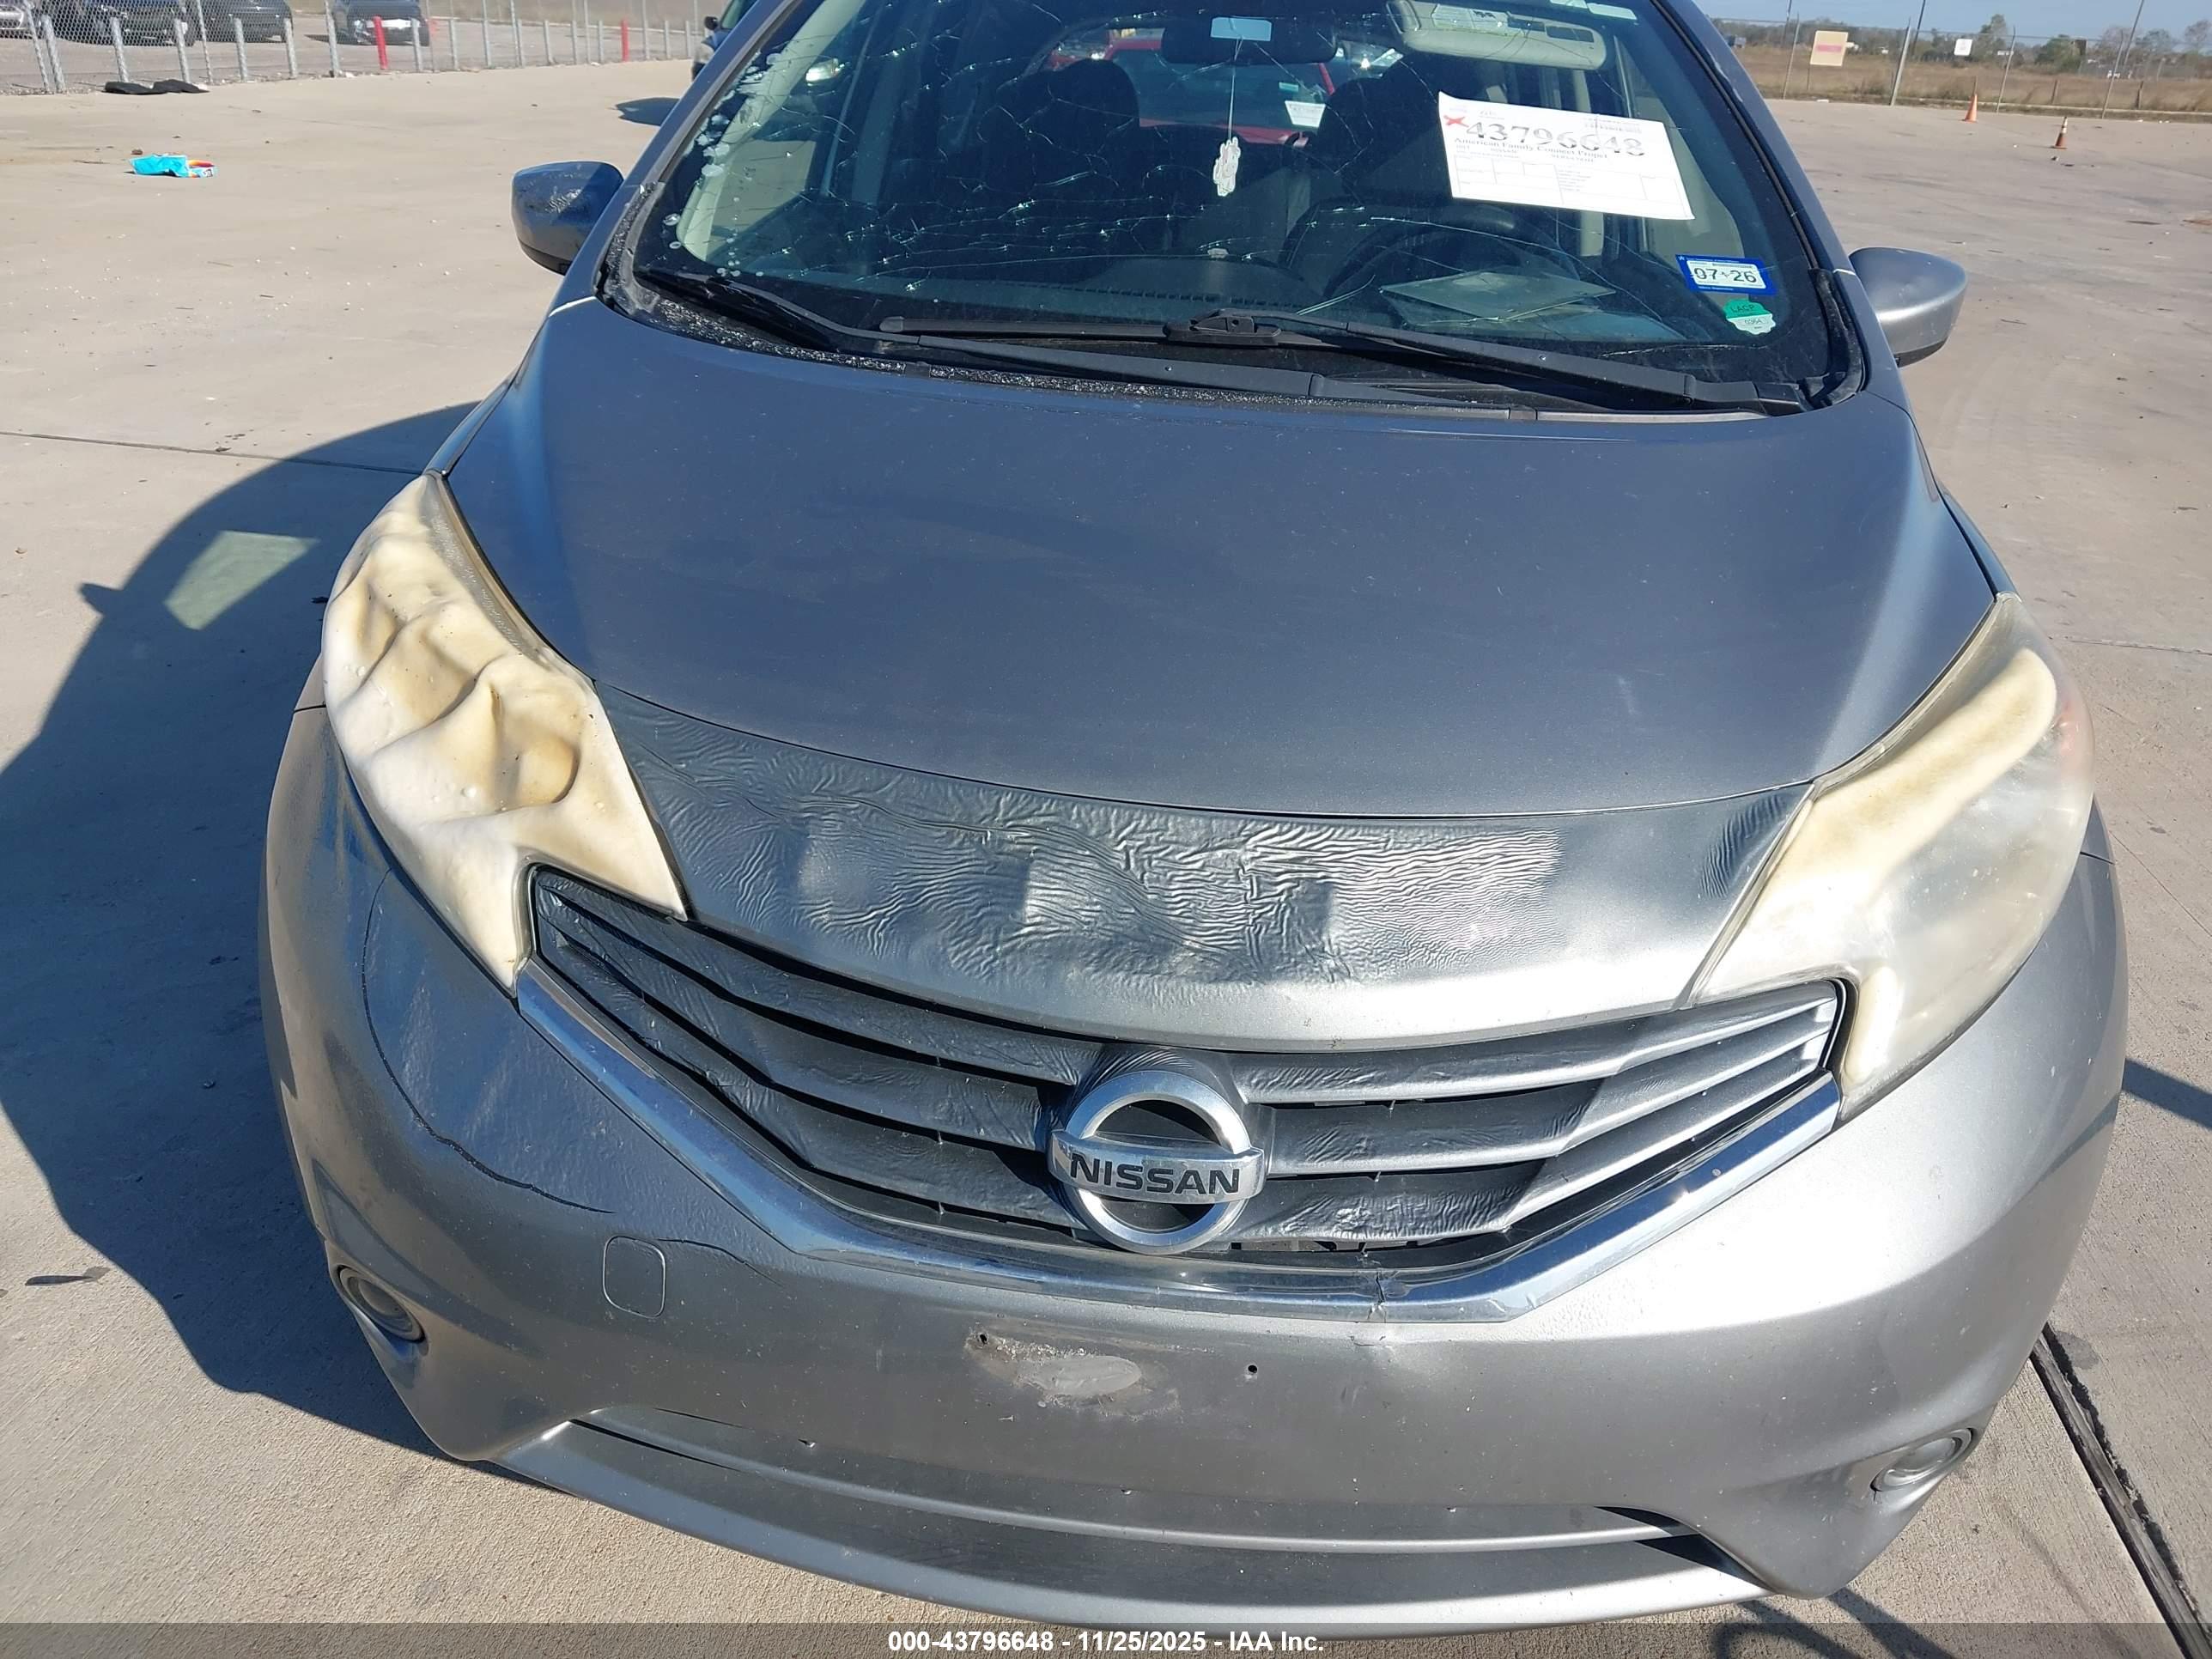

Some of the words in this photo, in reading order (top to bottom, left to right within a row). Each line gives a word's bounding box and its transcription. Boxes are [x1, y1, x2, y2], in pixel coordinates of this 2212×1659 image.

[1455, 137, 1499, 147] American
[1466, 122, 1646, 156] 43796648
[1730, 270, 1757, 283] 26
[1070, 1152, 1240, 1194] NISSAN
